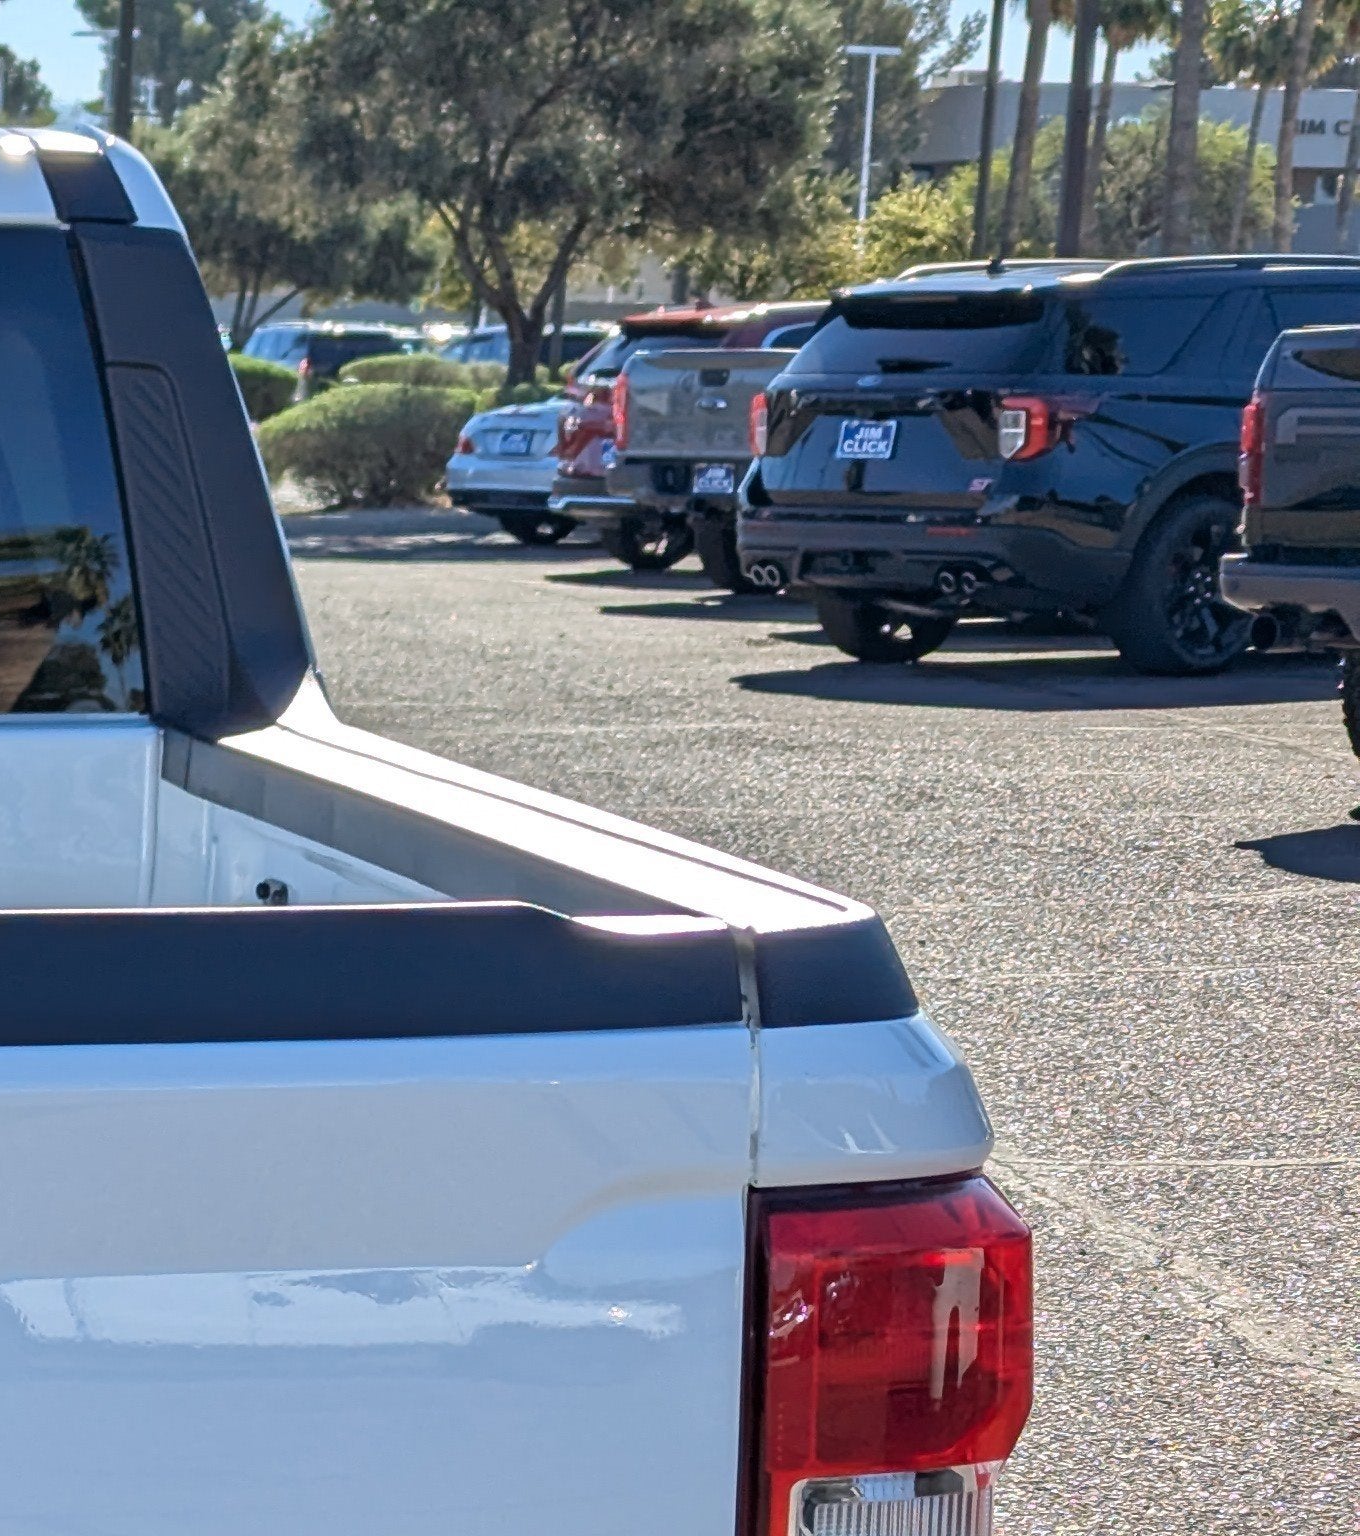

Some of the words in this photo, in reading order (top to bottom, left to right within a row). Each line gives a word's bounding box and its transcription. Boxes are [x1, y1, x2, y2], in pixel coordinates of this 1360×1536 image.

[1292, 118, 1327, 136] IM
[854, 427, 883, 440] JIM
[843, 439, 888, 453] CLICK
